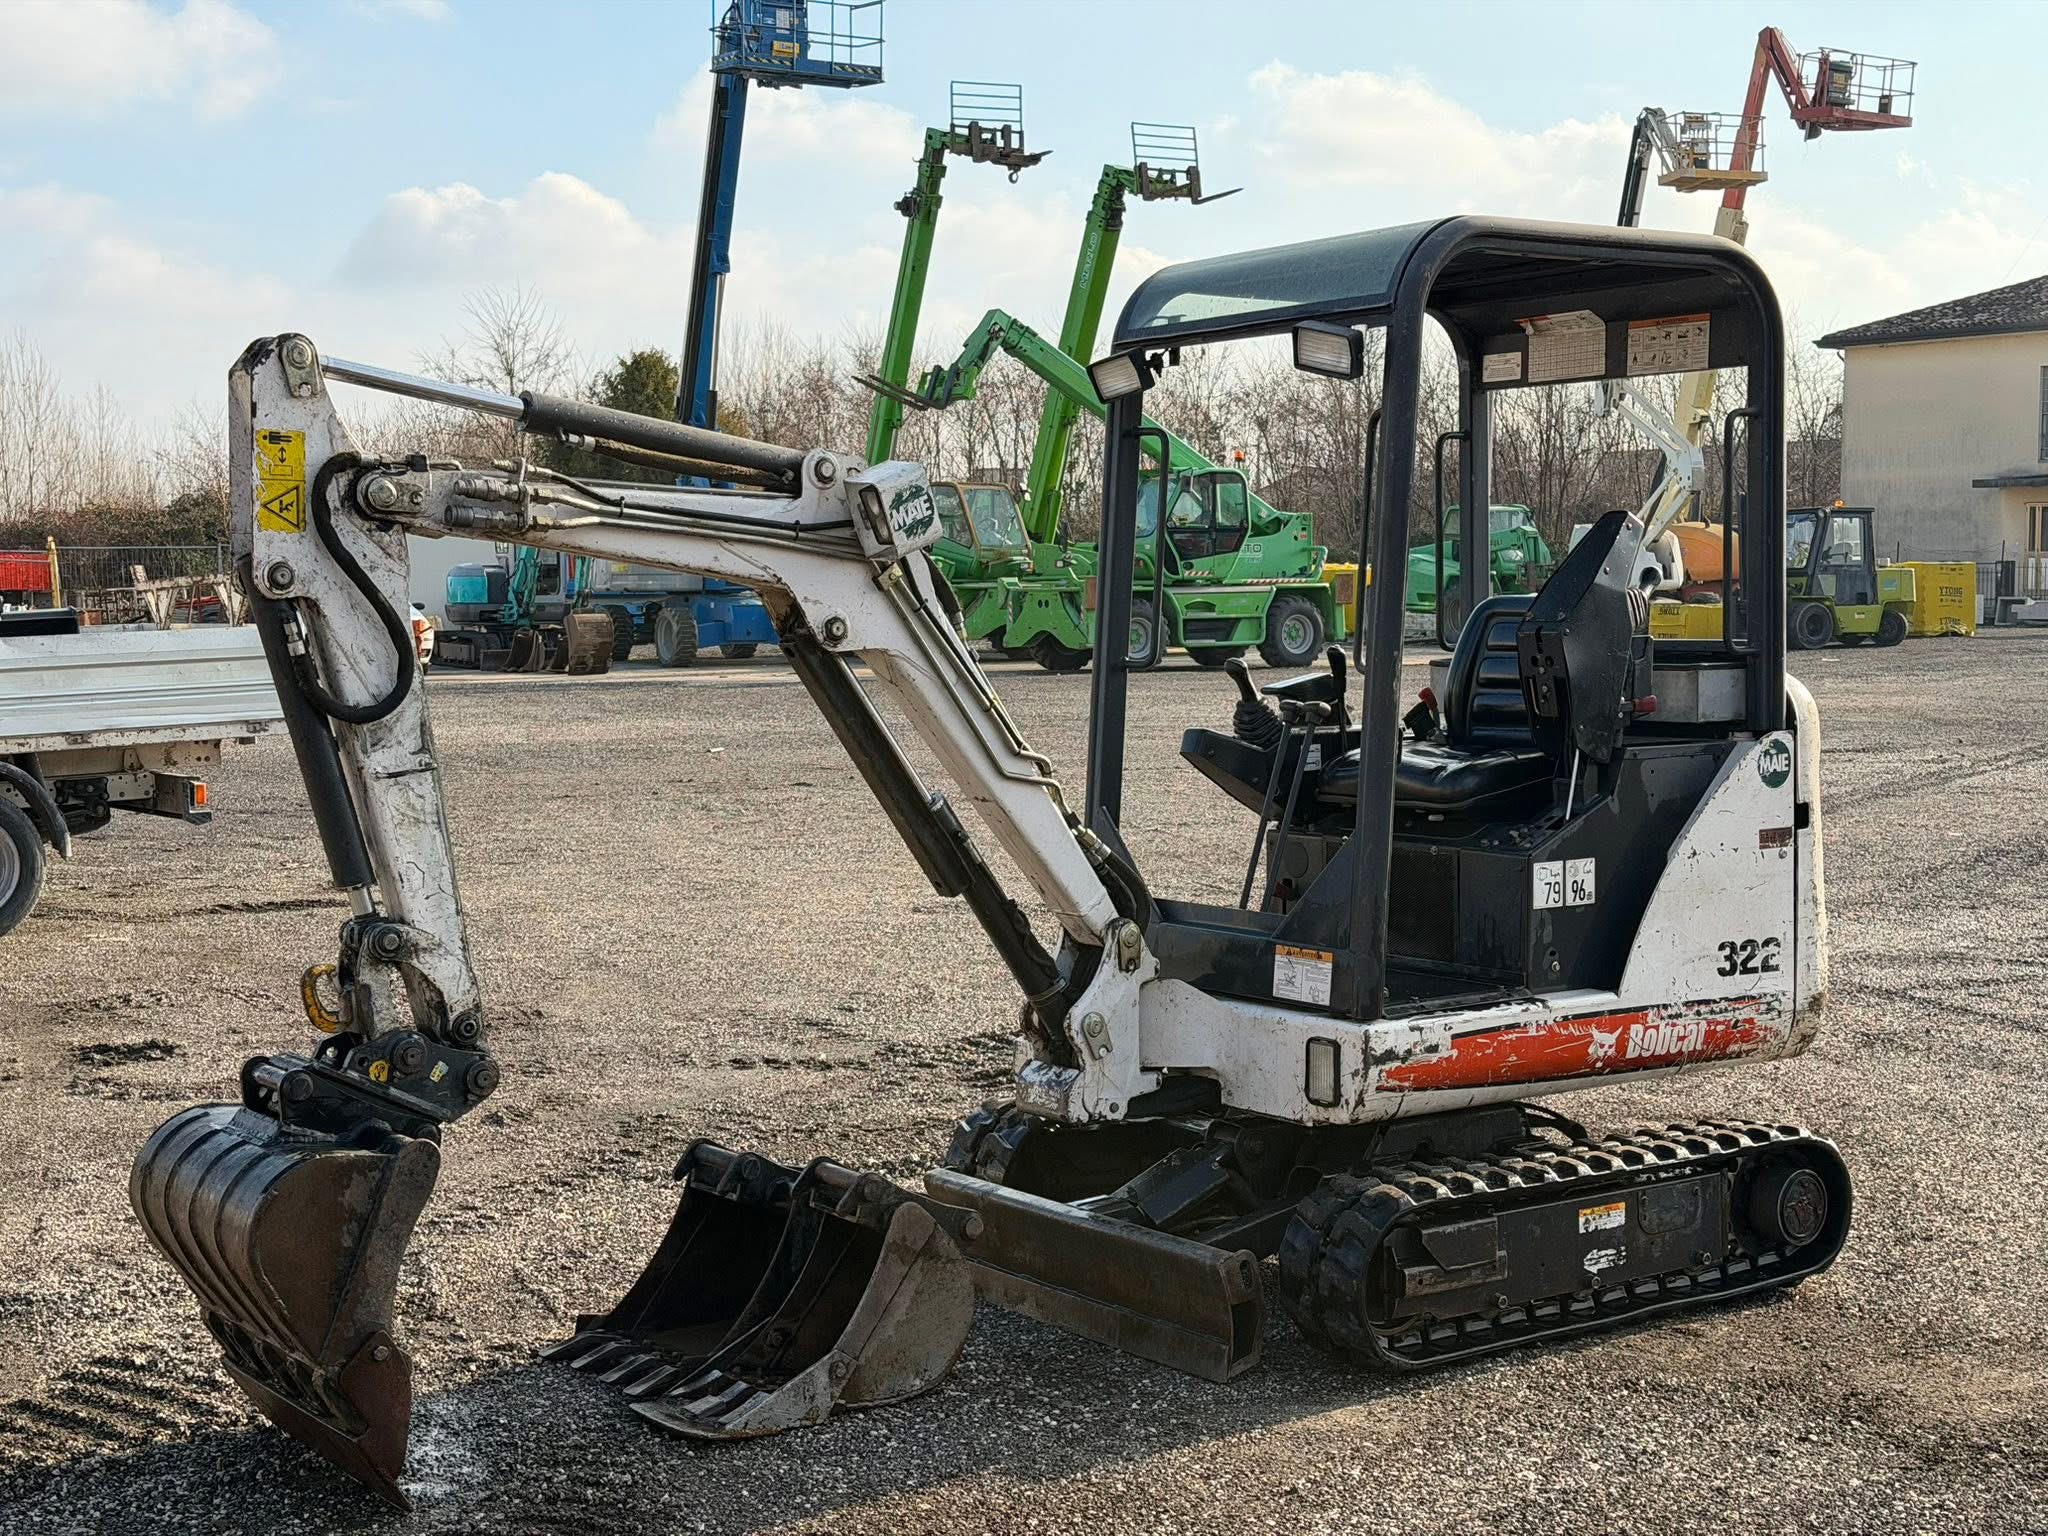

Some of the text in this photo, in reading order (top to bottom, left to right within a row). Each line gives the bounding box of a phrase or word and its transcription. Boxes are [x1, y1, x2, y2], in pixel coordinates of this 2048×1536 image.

[1939, 586, 1963, 596] YTONG
[1760, 753, 1790, 775] MAIE
[1544, 881, 1561, 905] 79
[1571, 878, 1586, 903] 96
[1717, 937, 1781, 977] 322
[1625, 1020, 1708, 1059] Bobcat
